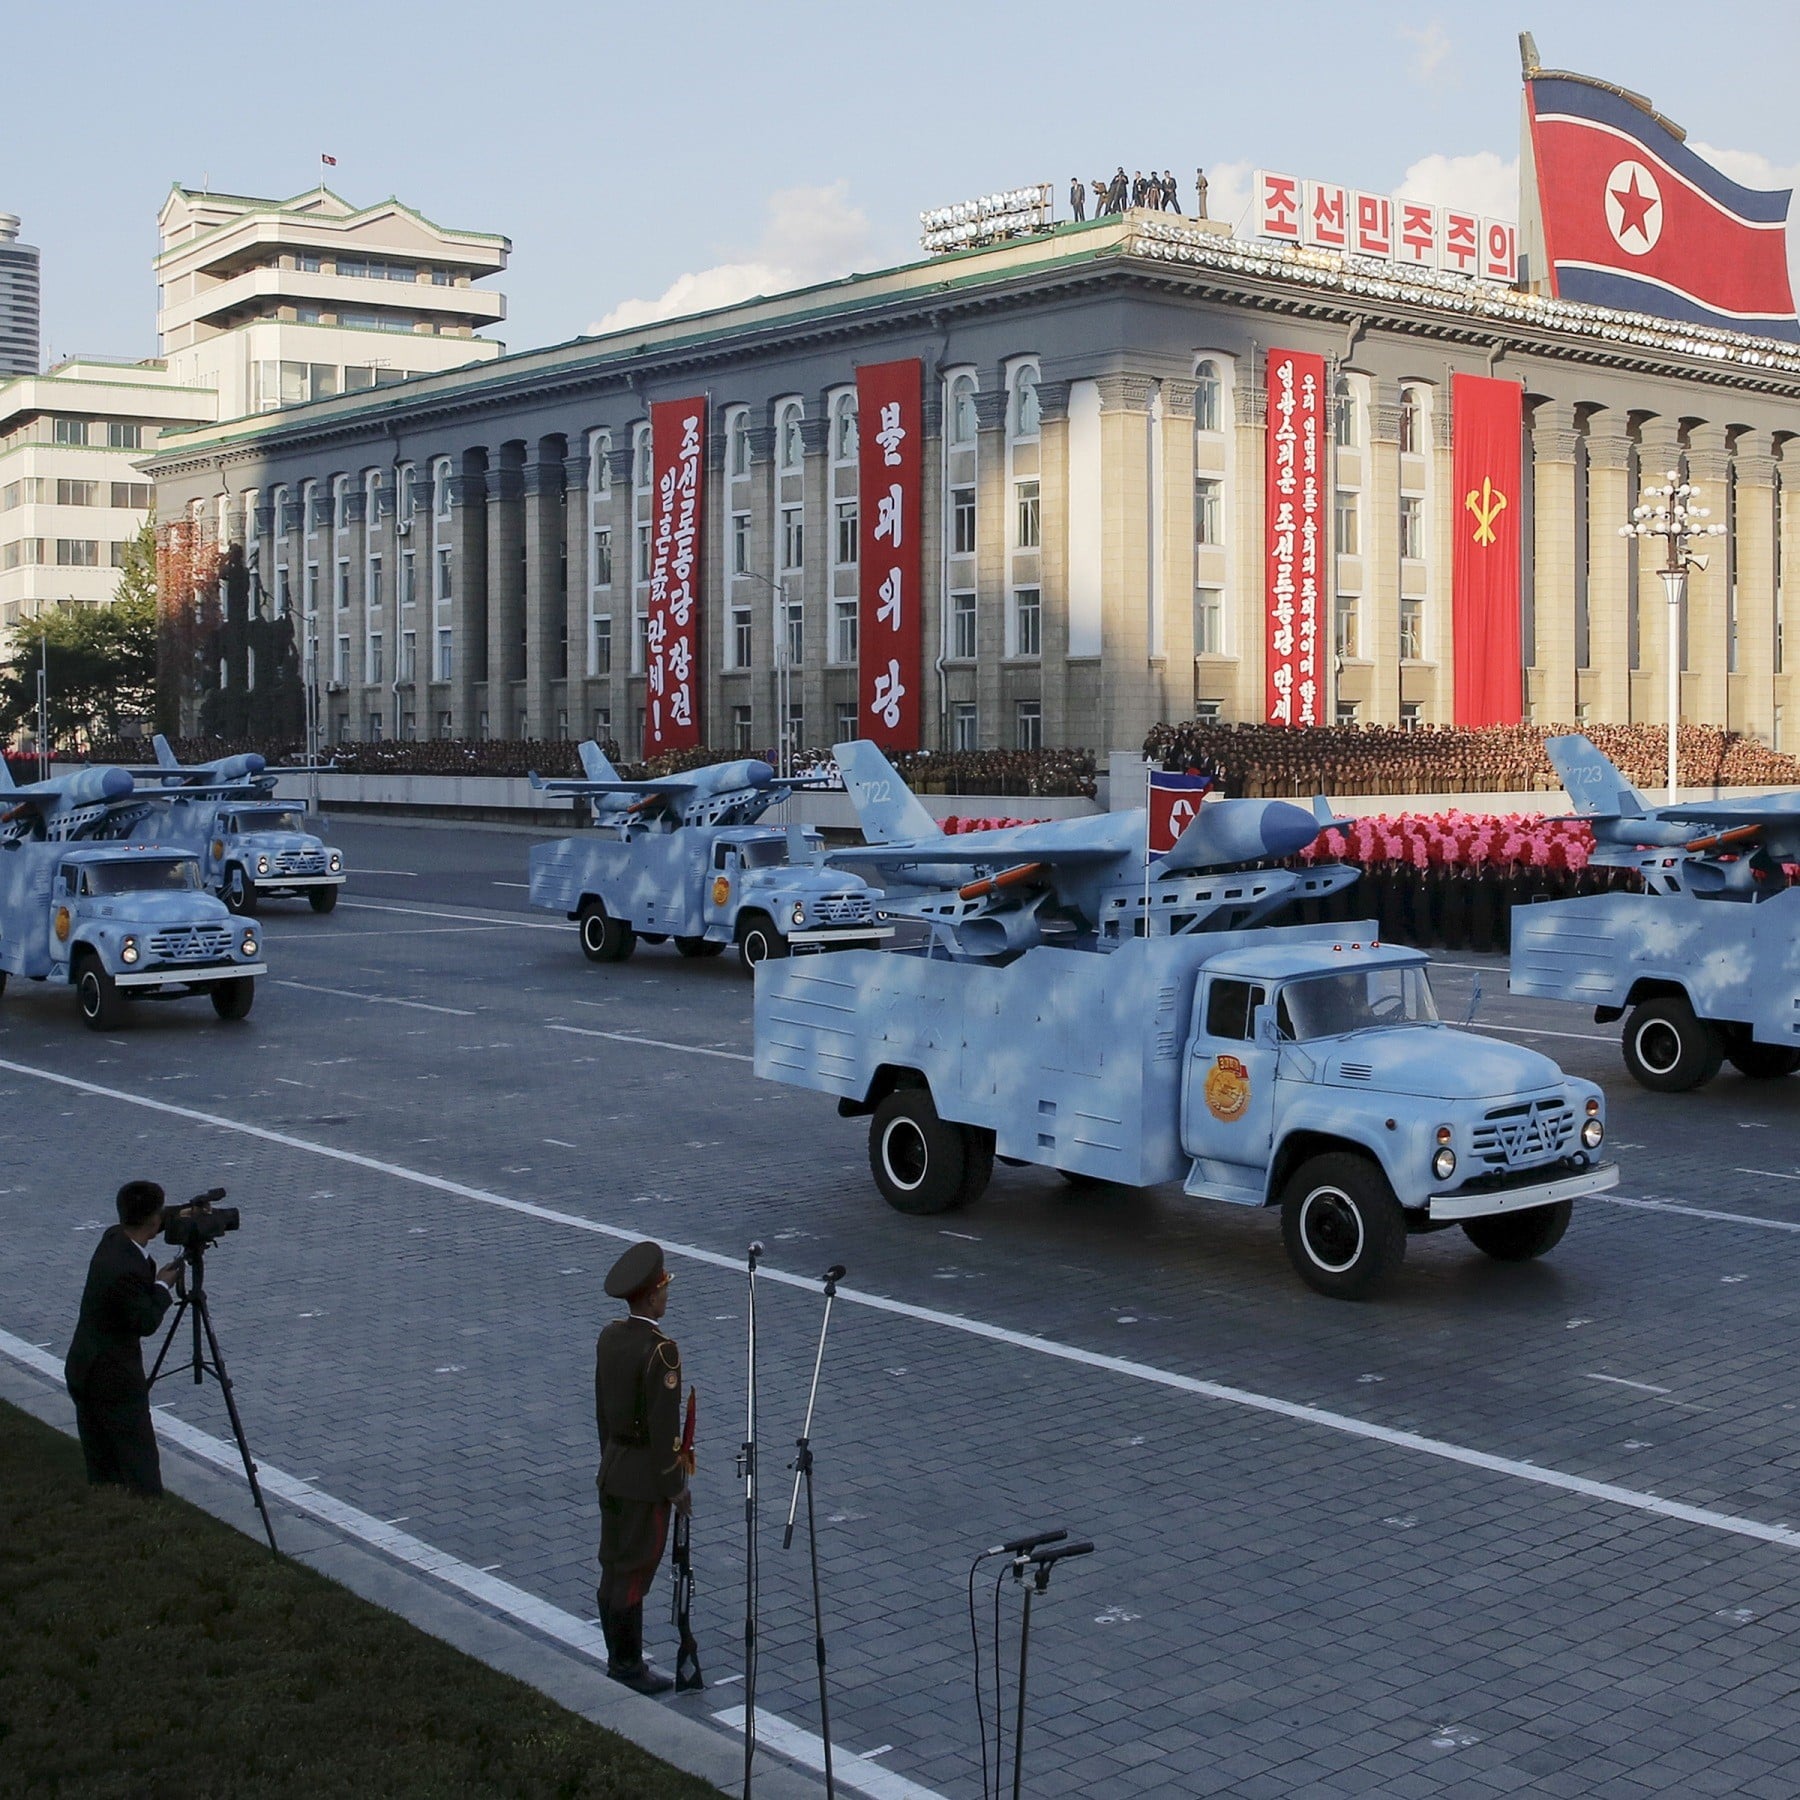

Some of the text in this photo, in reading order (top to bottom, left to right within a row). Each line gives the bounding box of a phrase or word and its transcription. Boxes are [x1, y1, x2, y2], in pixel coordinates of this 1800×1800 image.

[1264, 175, 1516, 279] 조선민주주의
[670, 416, 699, 725] 조선로동당 창건
[1271, 359, 1298, 727] 영광스러운 조선로동당 만세
[1298, 373, 1318, 727] 우리 인민의 모든 승리의 조직자이며 향도
[862, 781, 891, 804] 722
[1573, 765, 1602, 784] 723
